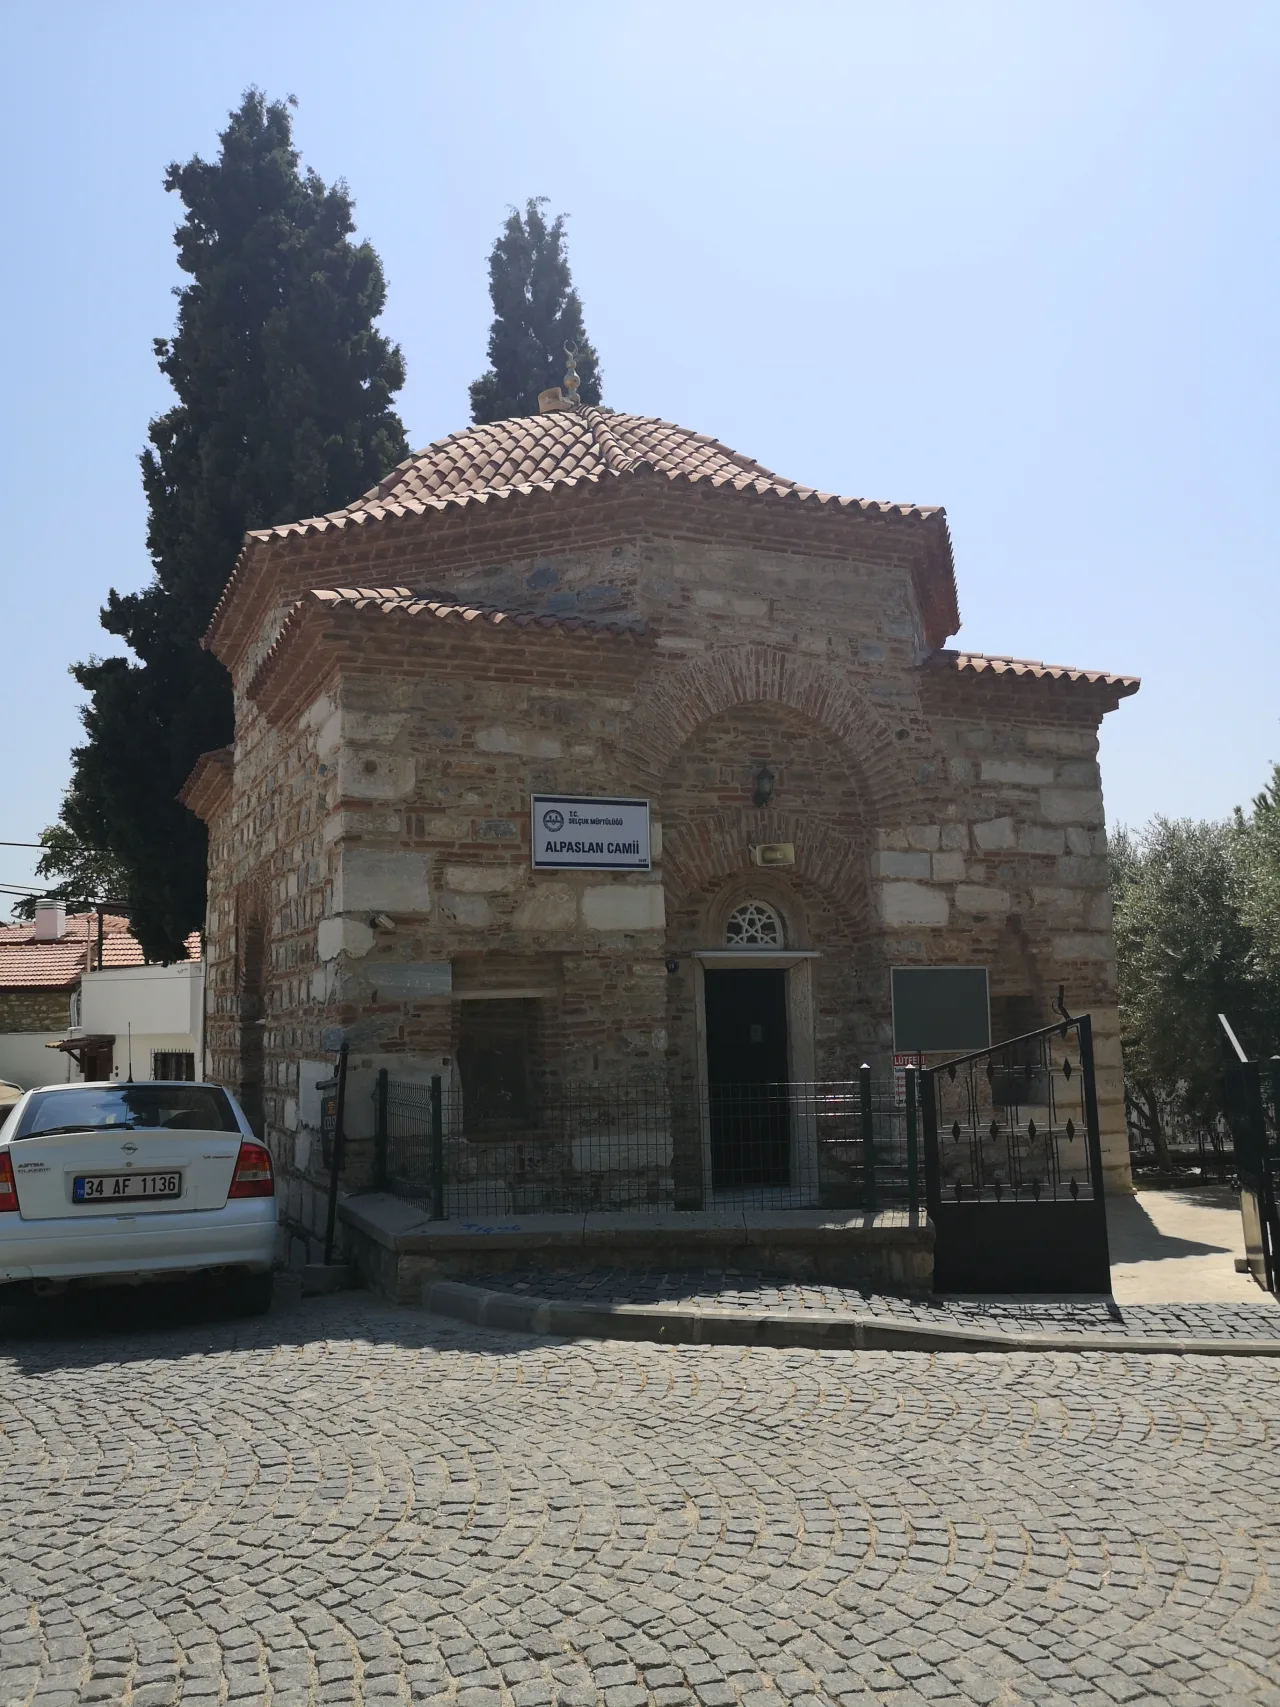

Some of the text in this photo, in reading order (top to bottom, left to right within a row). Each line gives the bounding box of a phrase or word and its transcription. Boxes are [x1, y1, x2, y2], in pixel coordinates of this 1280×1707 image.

[568, 818, 623, 826] SELÇUK MÜFTÜLÜĞÜ
[545, 840, 639, 855] ALPASLAN CAMİİ
[86, 1179, 104, 1196] 34
[113, 1178, 131, 1194] AF
[141, 1176, 176, 1194] 1136
